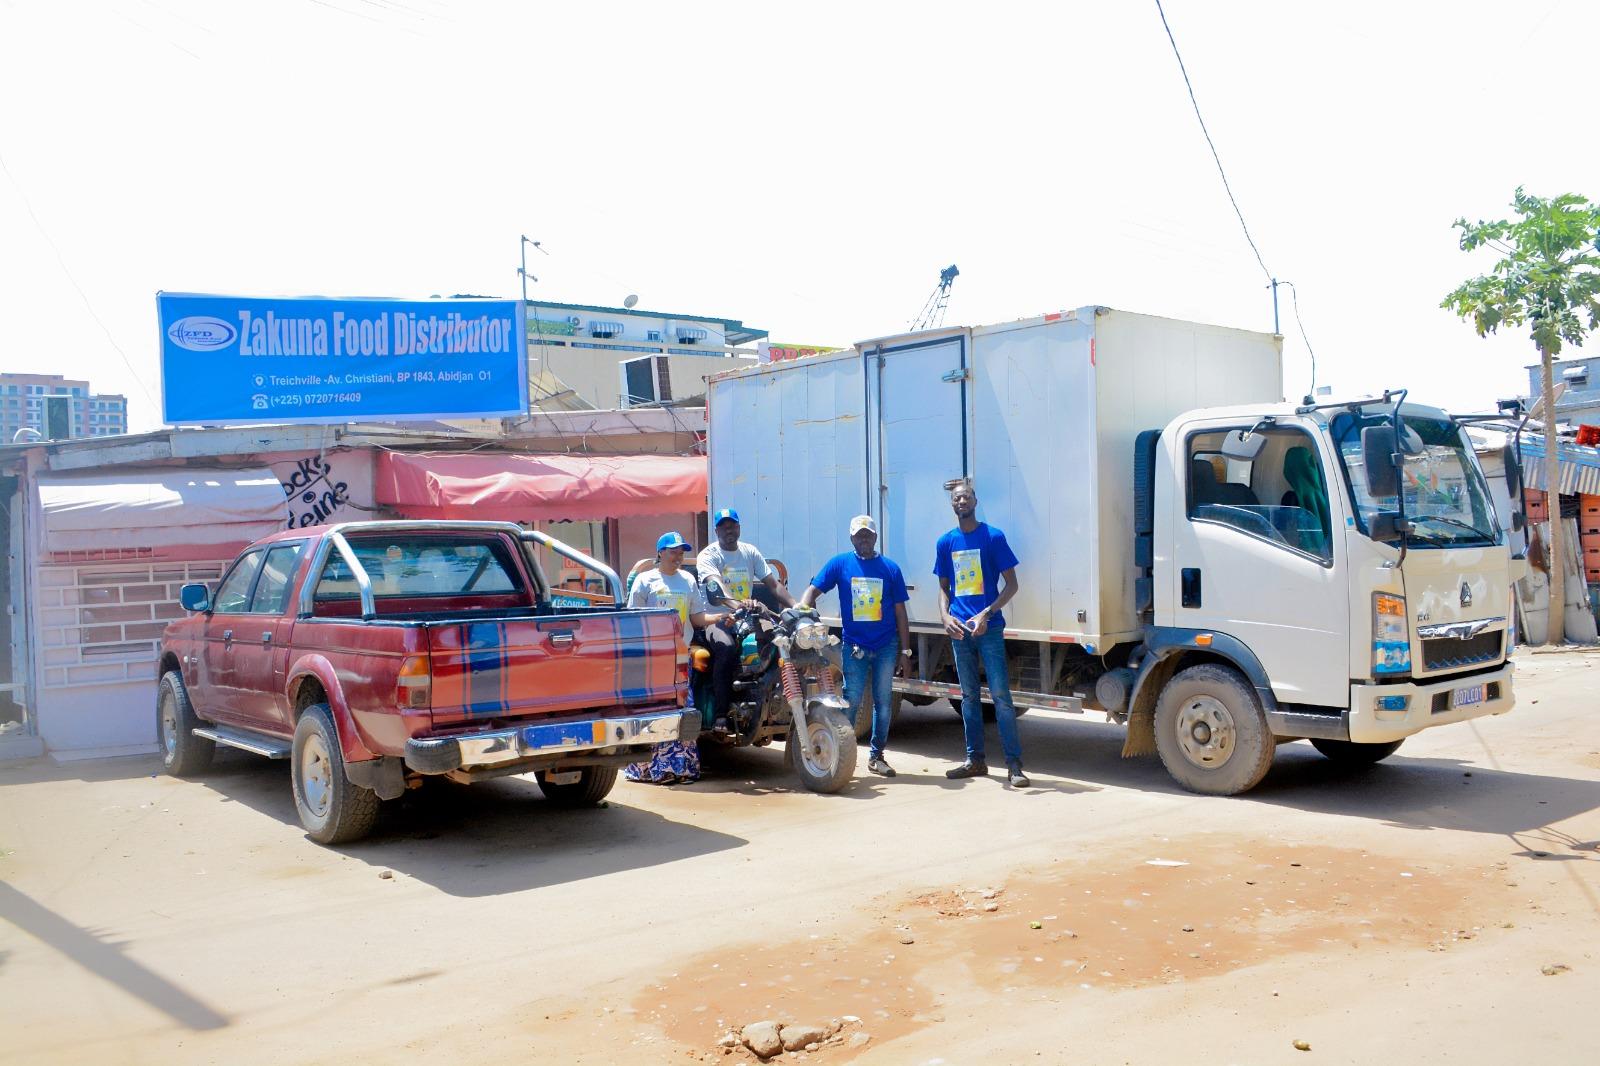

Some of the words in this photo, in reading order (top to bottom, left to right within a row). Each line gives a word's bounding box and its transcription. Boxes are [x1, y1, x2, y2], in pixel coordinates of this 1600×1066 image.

[238, 310, 328, 356] Zakuna
[333, 311, 389, 356] Food
[393, 312, 511, 355] Distributor
[270, 375, 321, 386] Treichville
[345, 373, 395, 385] Christiani,
[397, 371, 411, 382] BP
[412, 371, 436, 382] 1843,
[438, 370, 473, 383] Abidjan
[270, 394, 302, 407] (+225)
[304, 392, 361, 404] 0720716409
